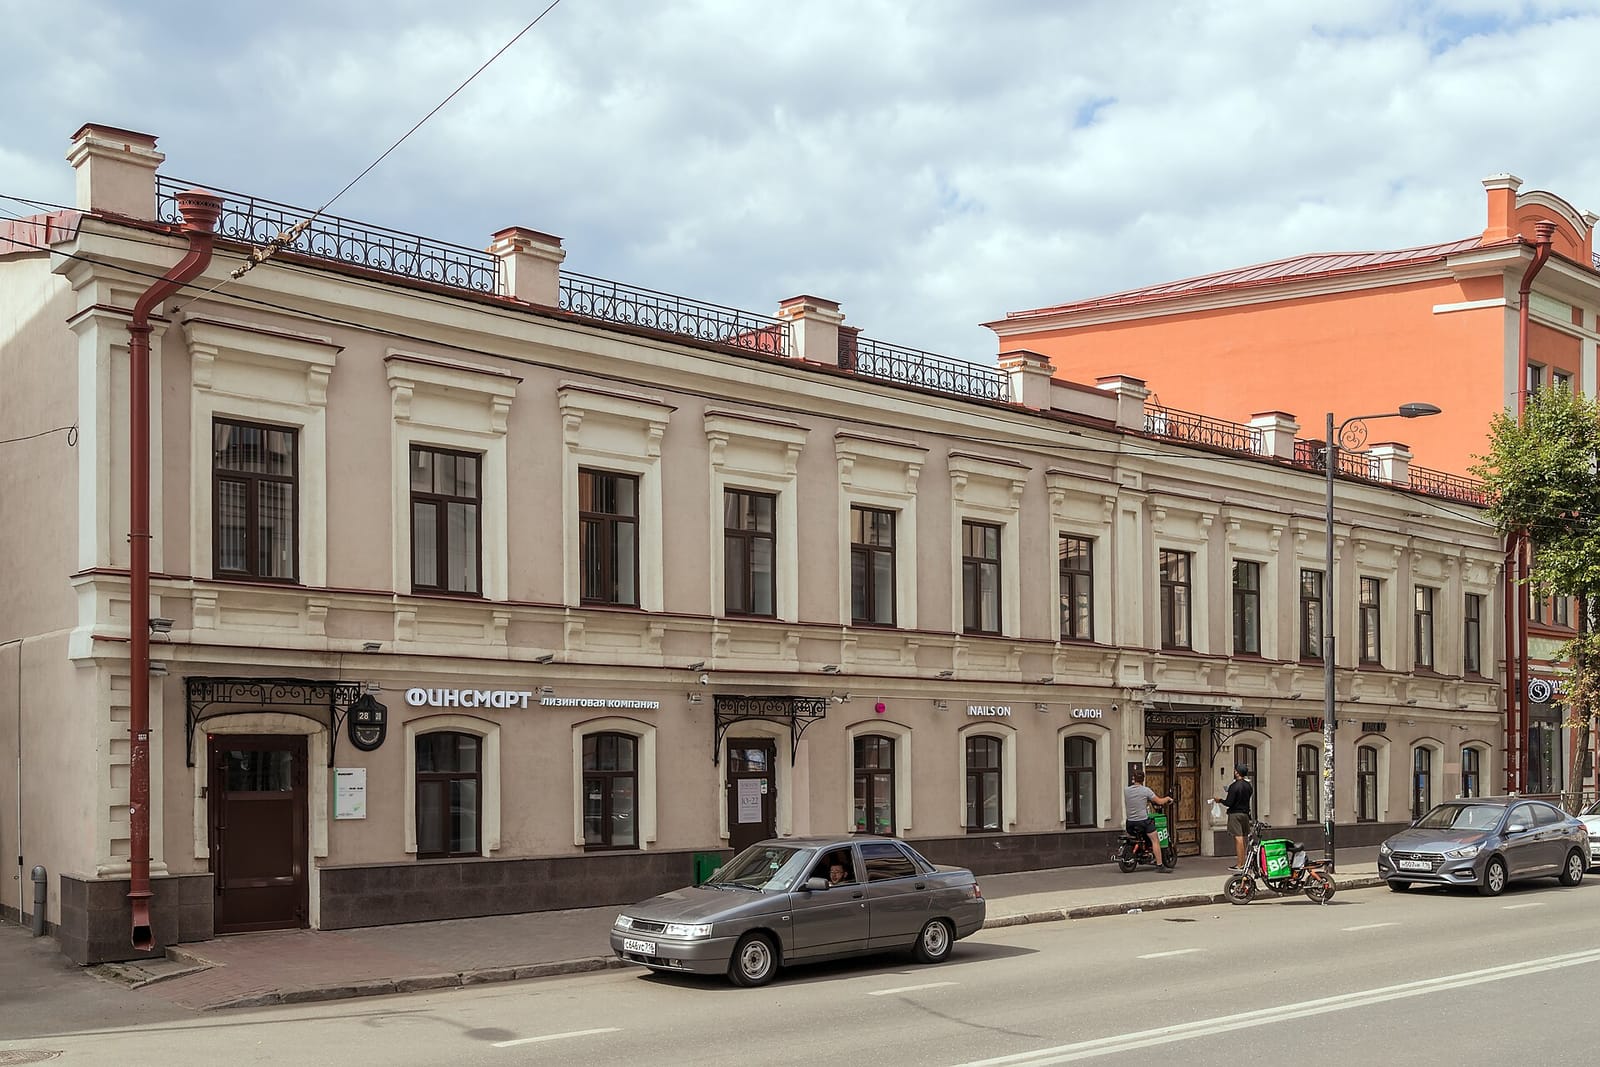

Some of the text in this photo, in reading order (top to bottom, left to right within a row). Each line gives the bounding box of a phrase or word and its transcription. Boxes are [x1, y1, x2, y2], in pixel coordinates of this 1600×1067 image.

[541, 697, 660, 709] лизинговая компания
[968, 705, 1011, 716] NAILS ON
[1072, 708, 1102, 718] САЛОН
[359, 712, 369, 720] 28
